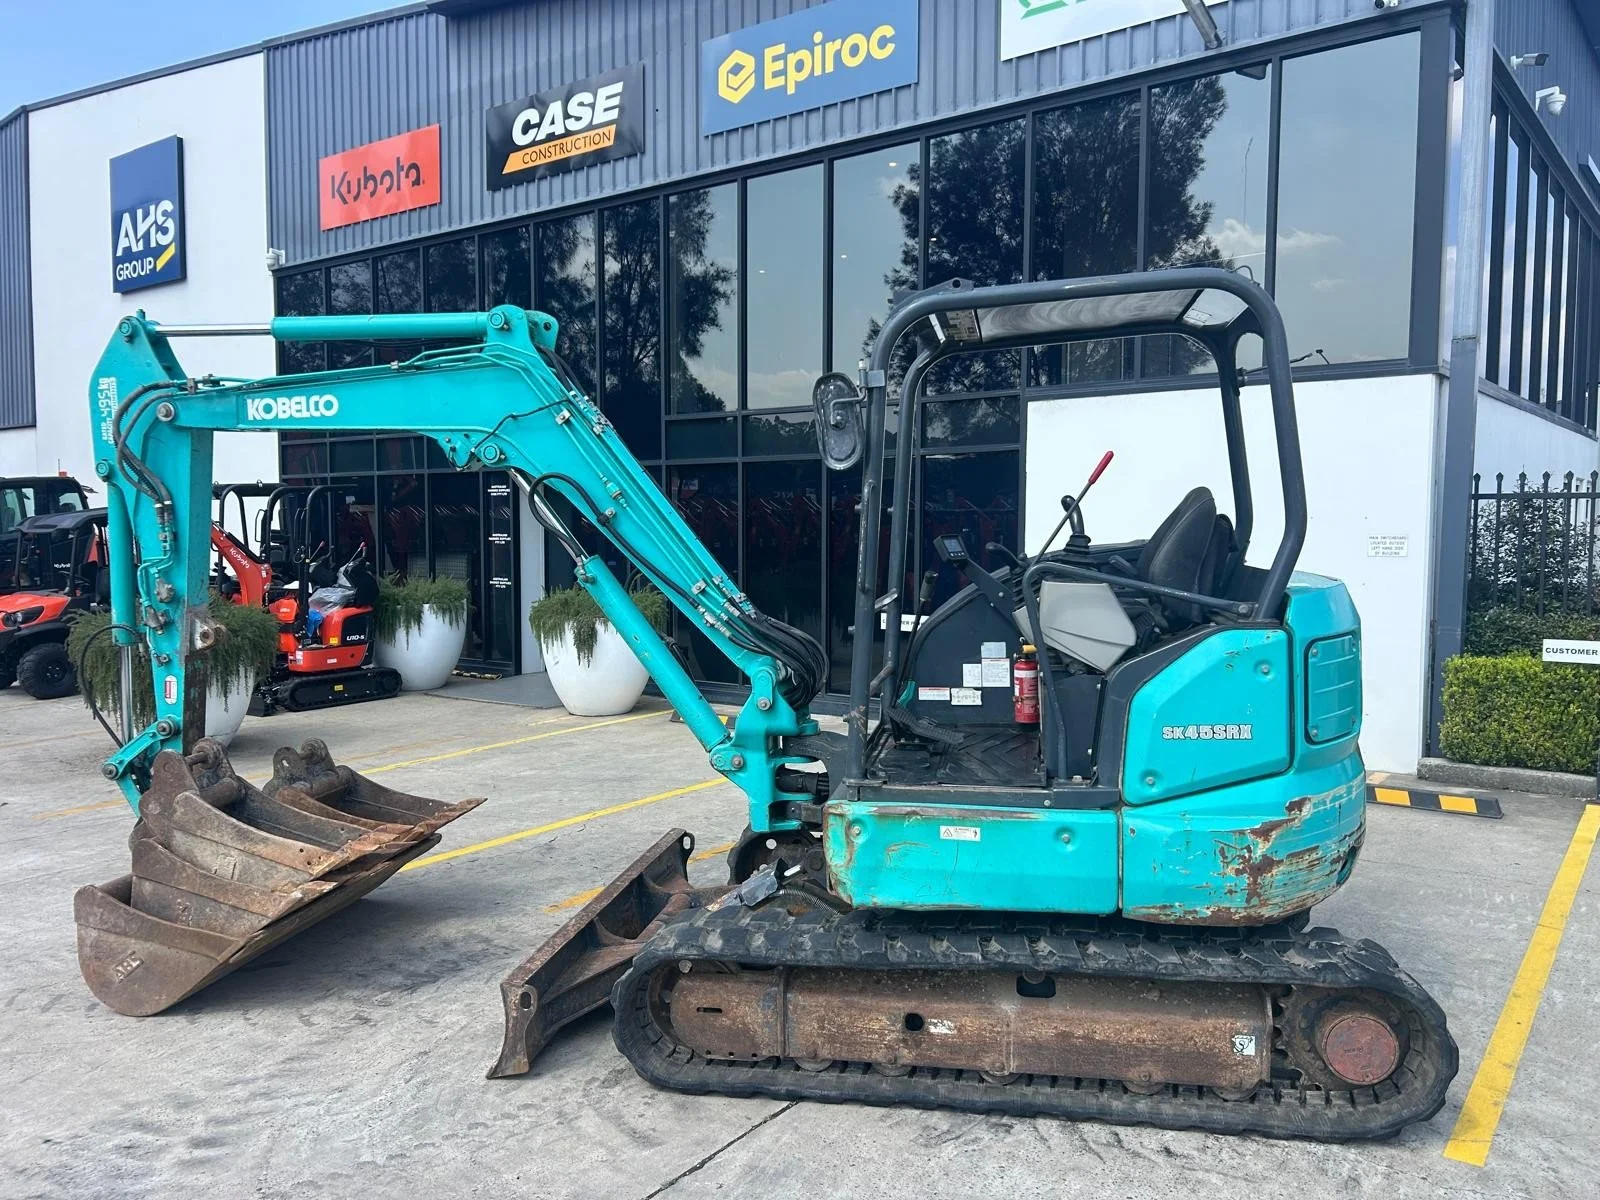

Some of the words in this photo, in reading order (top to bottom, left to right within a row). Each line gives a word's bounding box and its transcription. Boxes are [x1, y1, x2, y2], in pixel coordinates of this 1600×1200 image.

[764, 24, 896, 96] Epiroc
[512, 81, 624, 146] CASE
[522, 129, 611, 165] CONSTRUCTION
[331, 156, 421, 205] Kubota
[116, 200, 175, 257] AHS
[116, 257, 154, 281] GROUP
[246, 394, 339, 421] KOBELCO
[1545, 647, 1599, 656] CUSTOMER
[1162, 723, 1253, 740] SK45SRX
